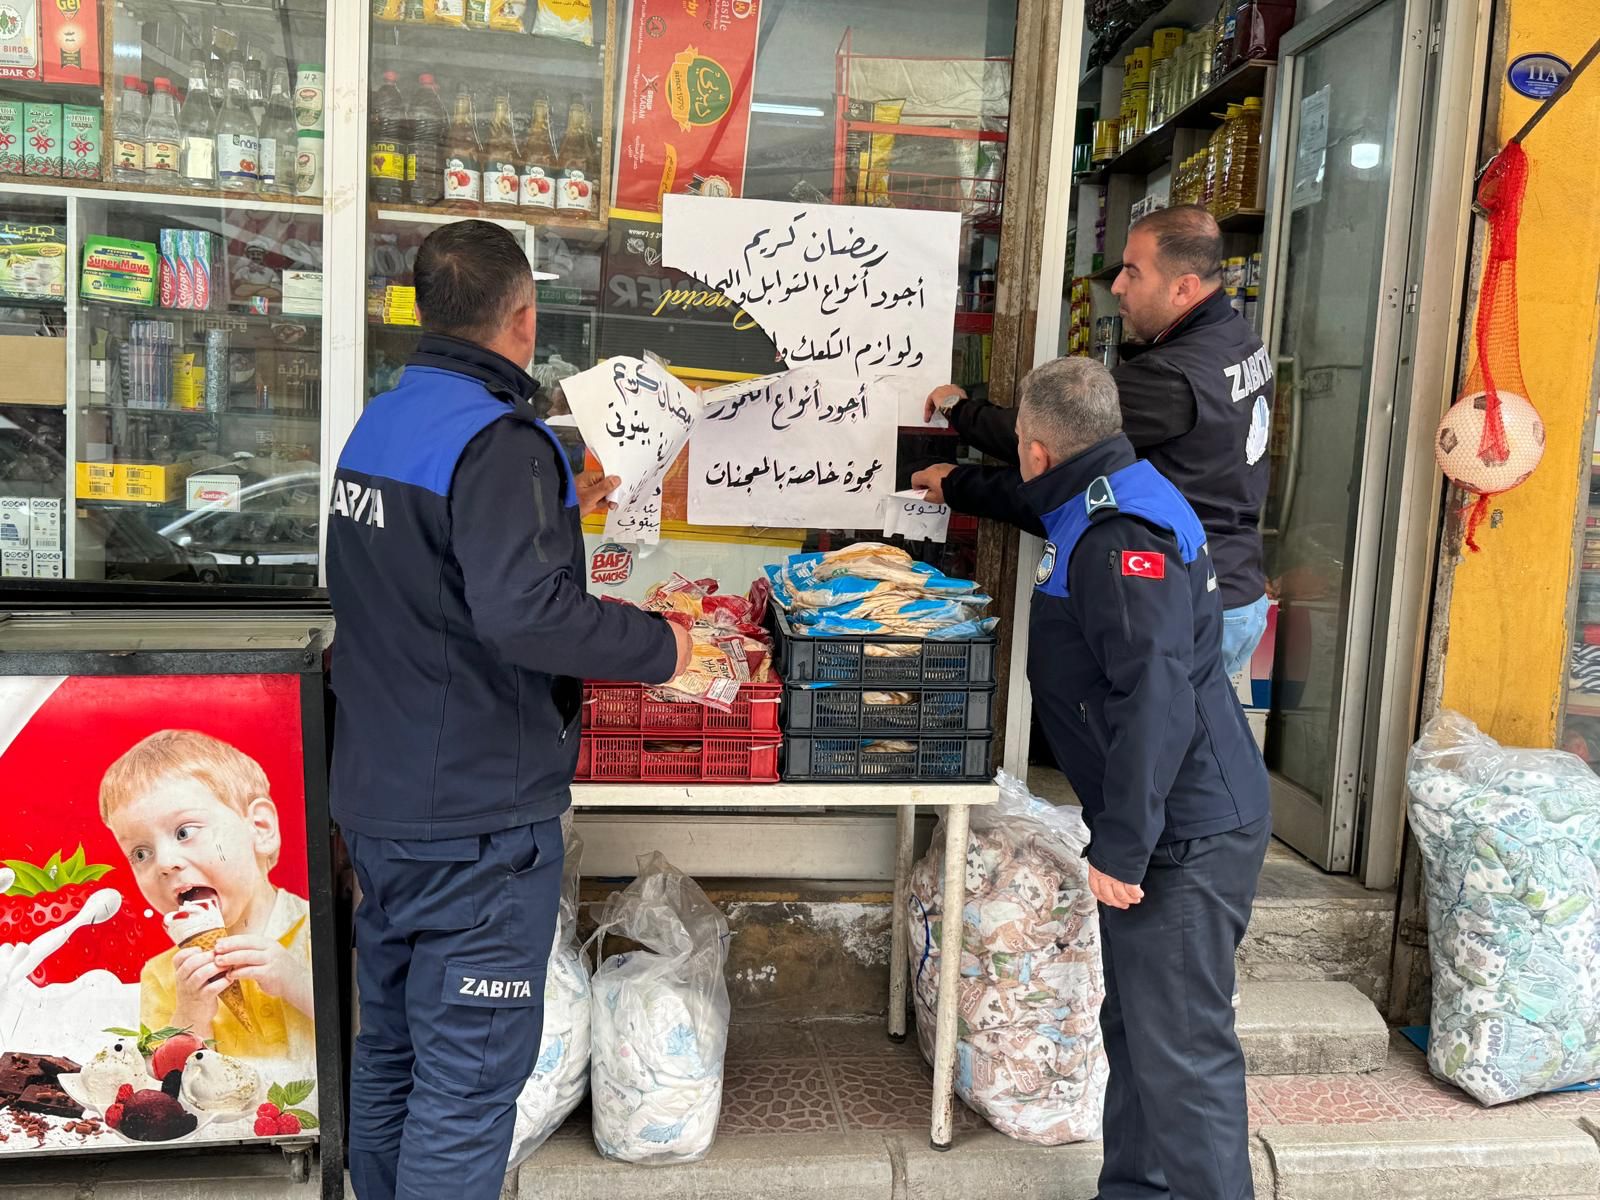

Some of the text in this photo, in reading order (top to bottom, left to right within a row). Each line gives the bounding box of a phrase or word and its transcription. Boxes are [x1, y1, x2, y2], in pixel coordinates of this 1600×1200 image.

[743, 211, 889, 276] رمضان كريم
[161, 265, 172, 305] Colgate
[178, 266, 188, 307] Colgate
[194, 267, 205, 308] Colgate
[748, 269, 818, 306] التوابل
[820, 268, 869, 315] أنواع
[870, 276, 925, 310] أجود
[790, 327, 851, 364] الكعك
[854, 334, 924, 378] ولوازم
[612, 362, 660, 406] كريم
[1223, 345, 1274, 403] ZABITA
[771, 378, 820, 431] أنواع
[819, 382, 868, 424] أجود
[705, 455, 786, 494] بالمعجنات
[786, 460, 840, 487] خاصة
[843, 458, 883, 493] عجوة
[590, 569, 629, 585] SNACKS
[459, 976, 532, 999] ZABITA
